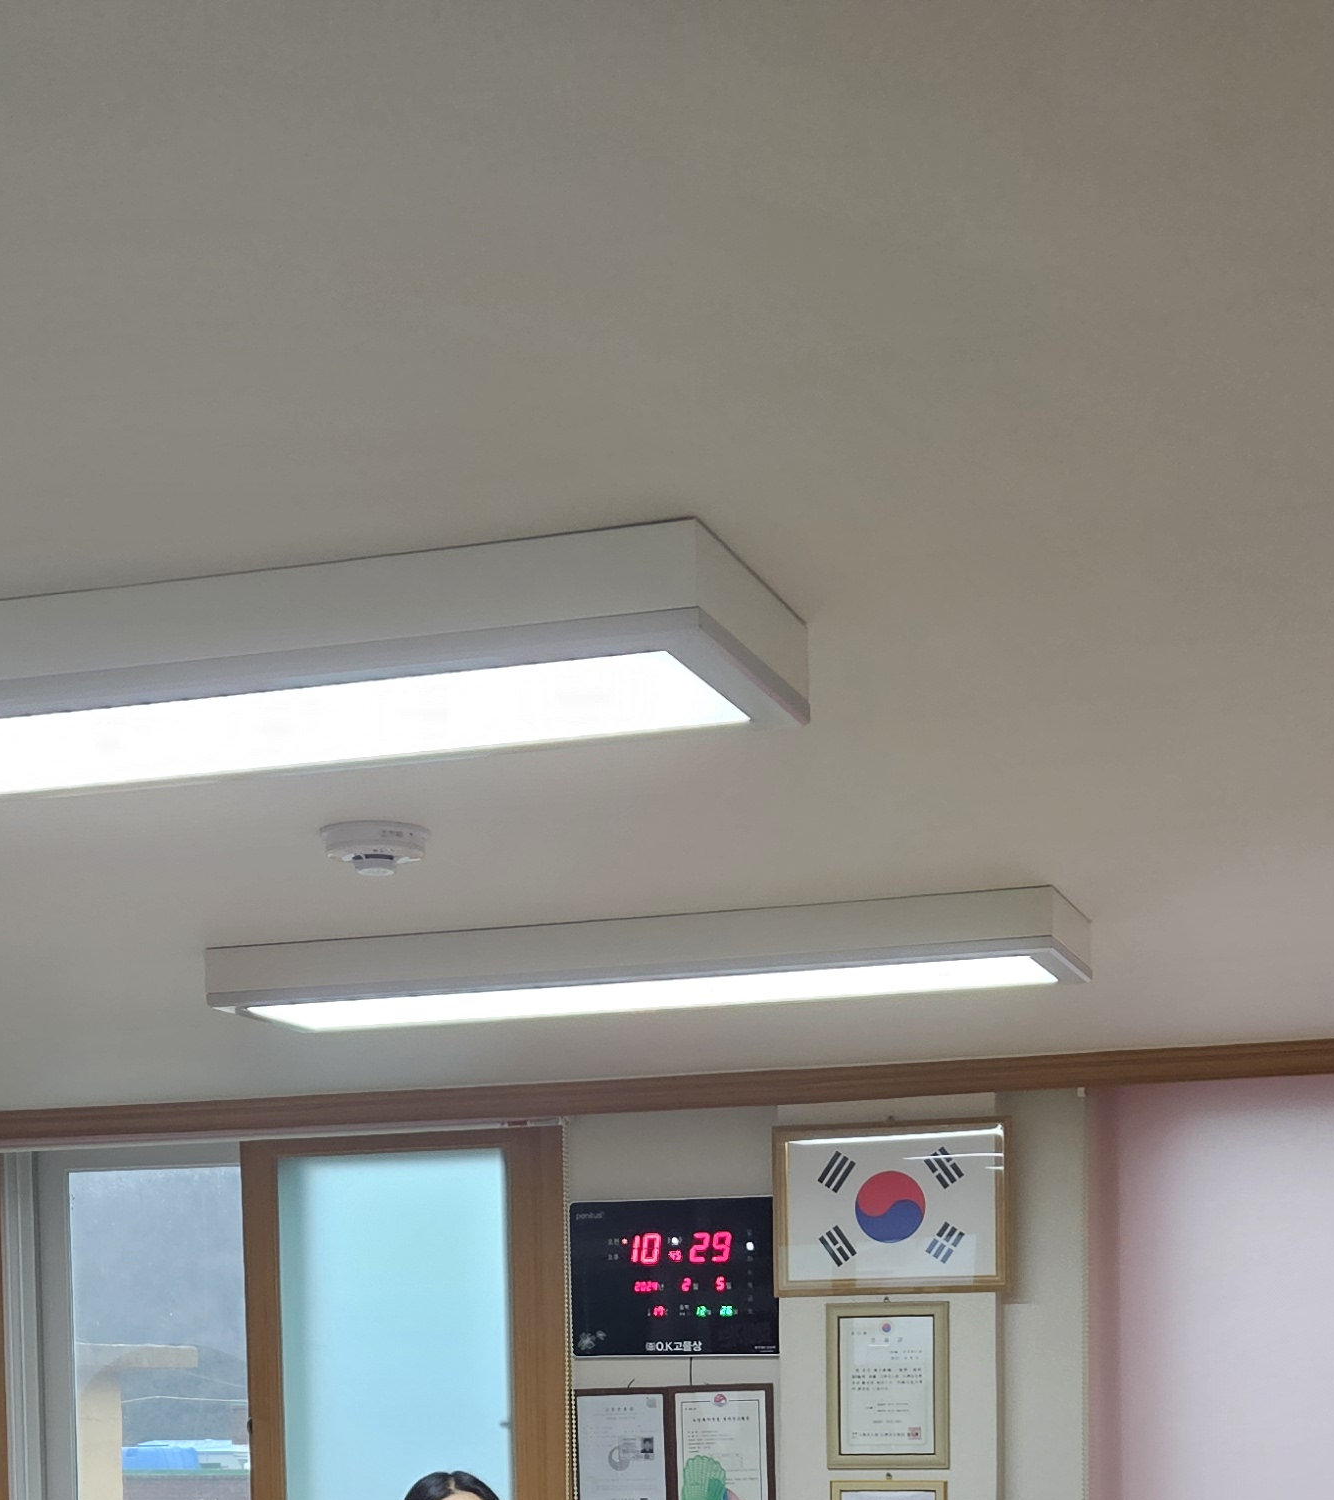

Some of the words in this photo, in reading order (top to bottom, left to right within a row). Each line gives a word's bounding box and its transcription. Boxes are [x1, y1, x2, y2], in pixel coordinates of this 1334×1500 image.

[630, 1232, 661, 1264] 10
[689, 1231, 733, 1263] 29
[681, 1277, 692, 1292] 2
[715, 1276, 726, 1293] 5
